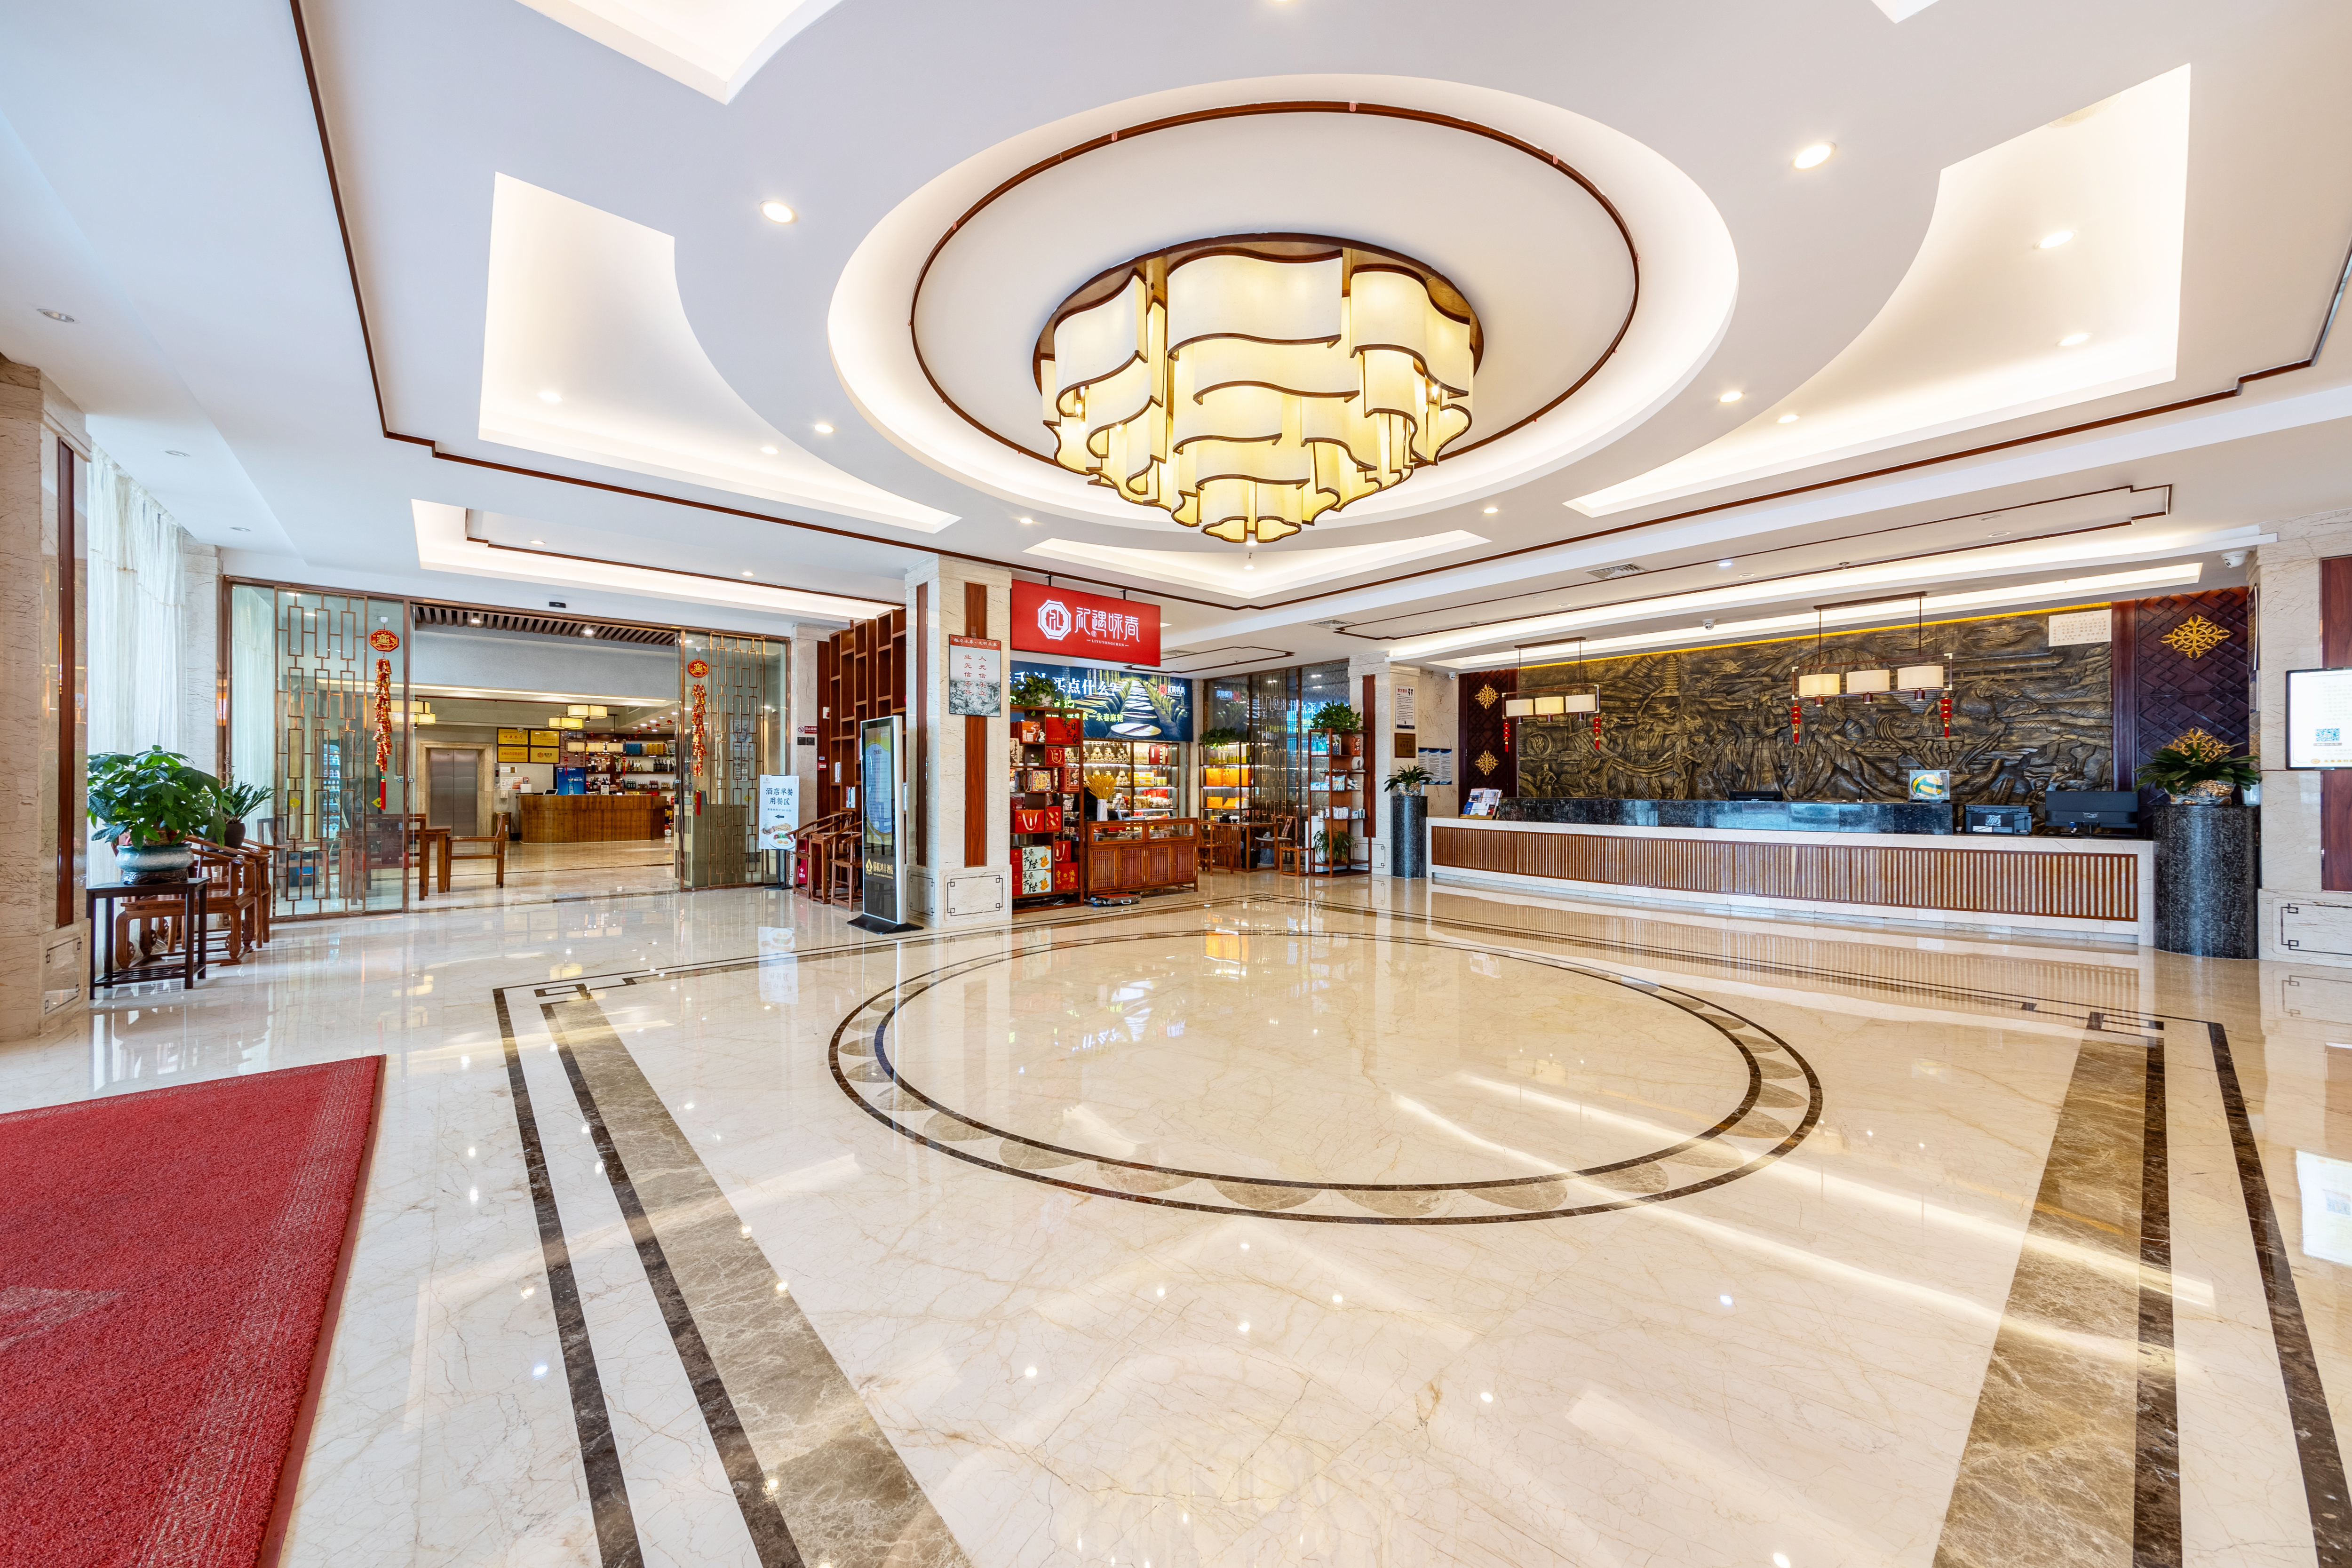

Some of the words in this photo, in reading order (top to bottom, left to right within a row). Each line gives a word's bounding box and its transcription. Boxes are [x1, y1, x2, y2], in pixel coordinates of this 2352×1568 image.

[1074, 606, 1140, 642] 礼遇咏春
[964, 654, 972, 695] 业无信不兴
[766, 788, 794, 796] 酒店早餐
